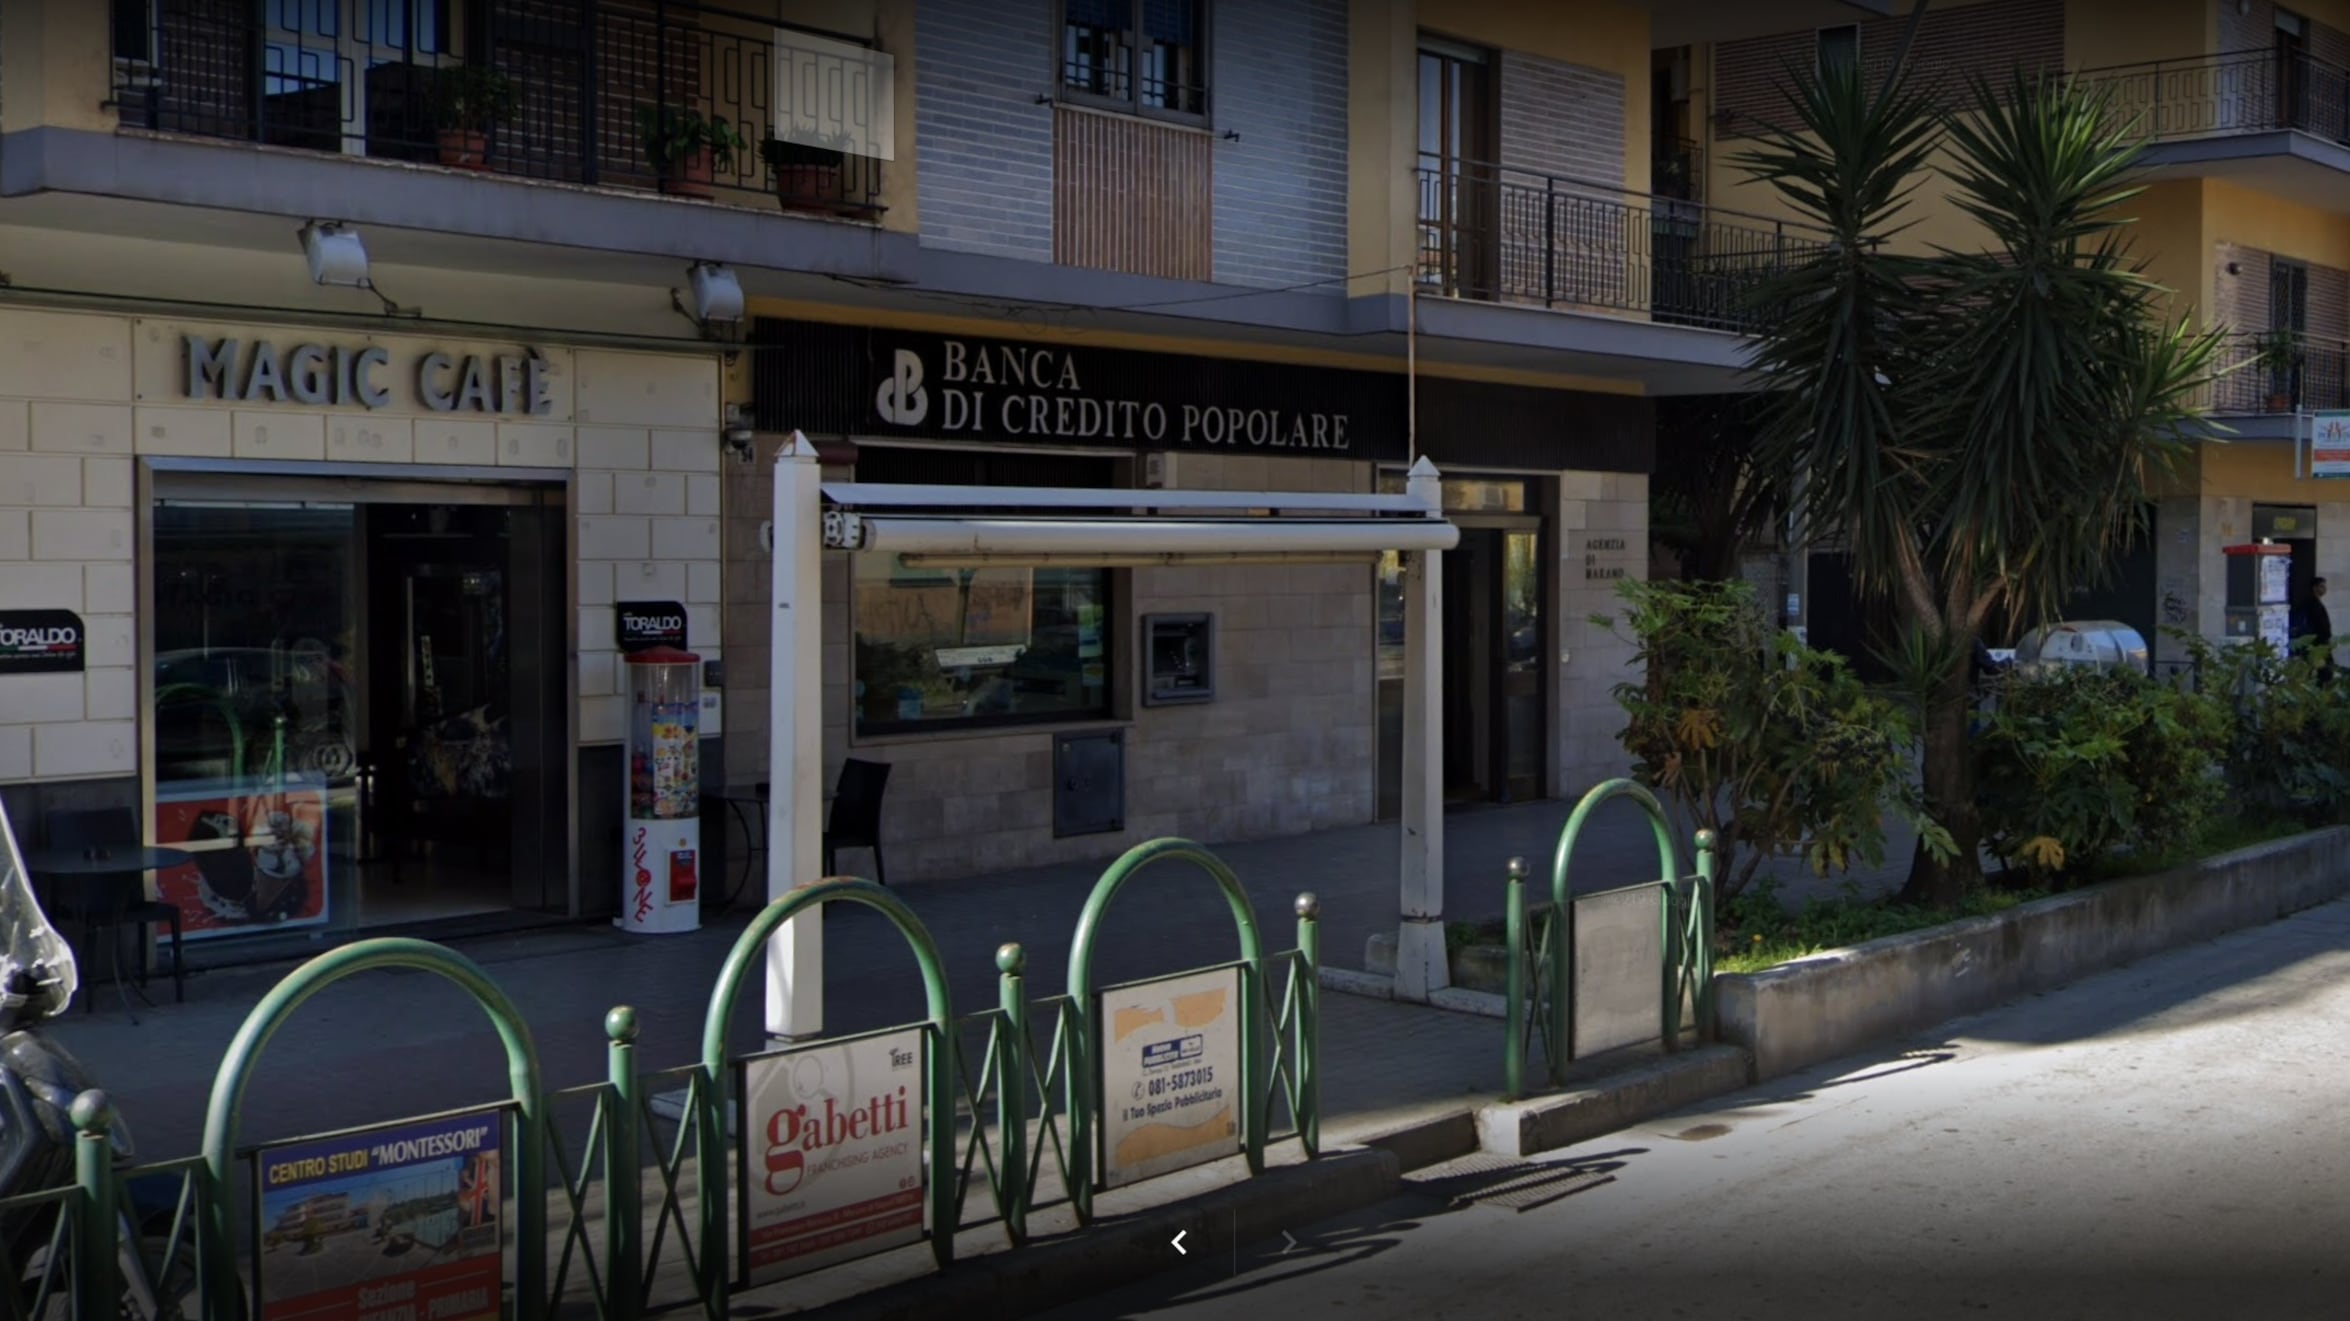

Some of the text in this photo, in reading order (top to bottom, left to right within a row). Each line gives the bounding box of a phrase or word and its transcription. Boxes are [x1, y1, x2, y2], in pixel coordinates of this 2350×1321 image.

[182, 333, 390, 409] MAGIC
[943, 339, 1081, 393] BANCA
[942, 388, 1351, 450] DI CREDITO POPOLARE
[1585, 538, 1626, 550] AGENZIA
[622, 614, 683, 632] TORALDO
[1147, 1065, 1214, 1097] 081-5873015
[1130, 1106, 1145, 1120] Tuo
[1146, 1098, 1173, 1118] Spazio
[764, 1085, 910, 1196] gabetti
[268, 1155, 325, 1185] CENTRO
[327, 1149, 369, 1174] STUDI
[807, 1141, 910, 1177] FRANCHISING AGENCY
[356, 1279, 417, 1310] Sezione
